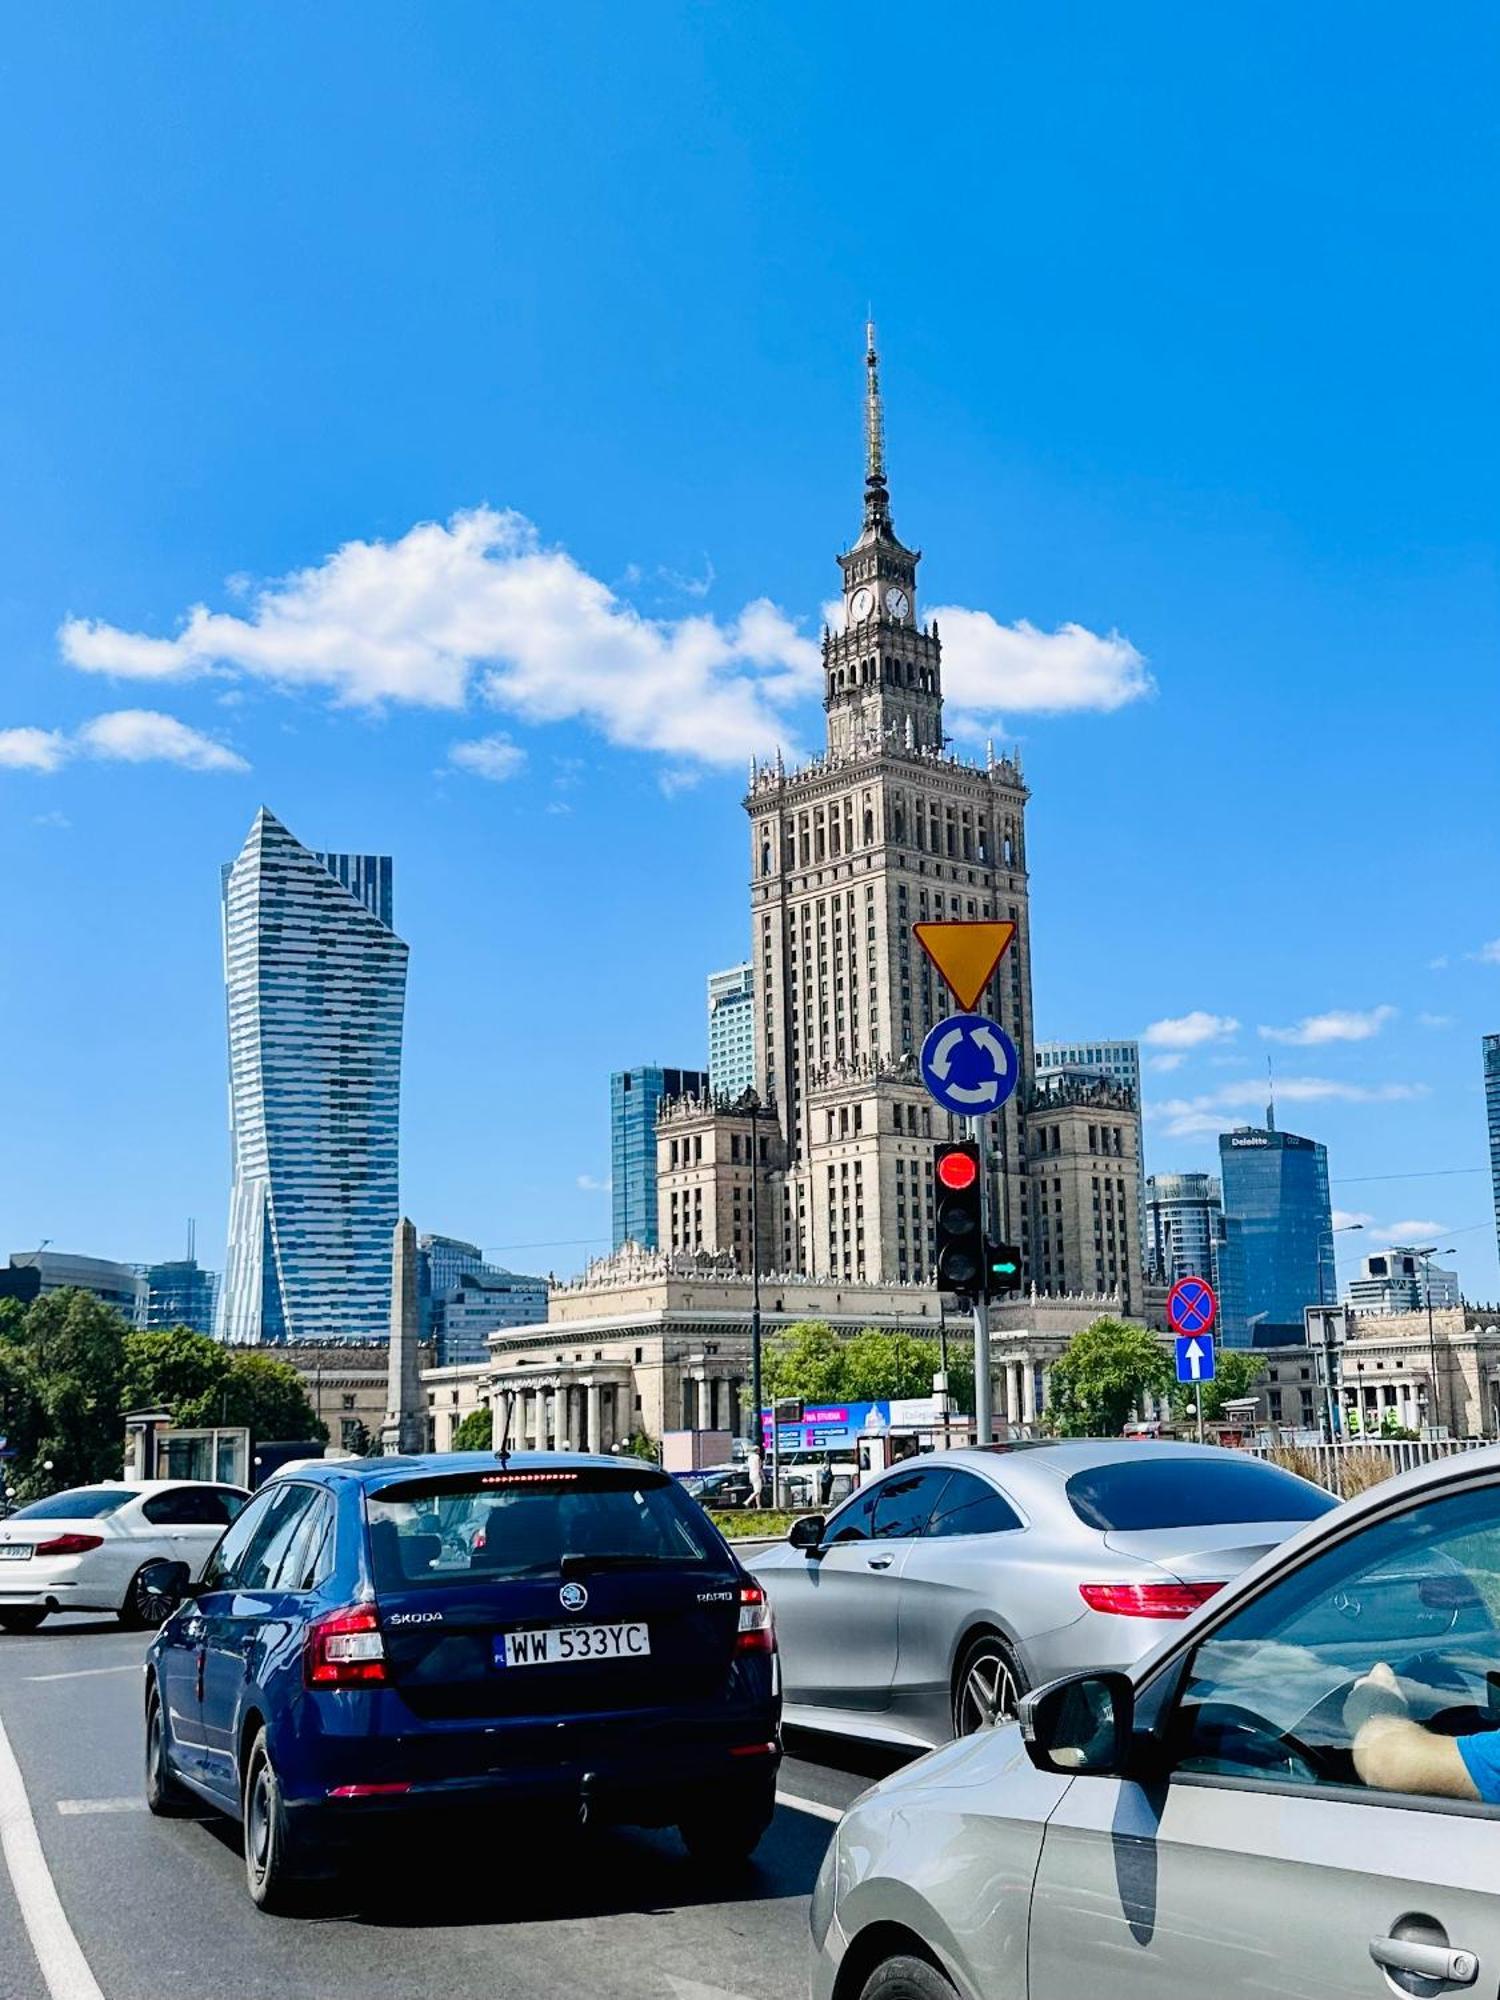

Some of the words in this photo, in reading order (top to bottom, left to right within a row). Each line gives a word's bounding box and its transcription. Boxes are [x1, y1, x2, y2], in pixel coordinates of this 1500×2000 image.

[1231, 1137, 1268, 1146] Deloitte
[696, 1591, 733, 1602] RAPID
[391, 1612, 443, 1625] ŠKODA
[512, 1633, 547, 1663] WW
[559, 1626, 642, 1658] 533YC
